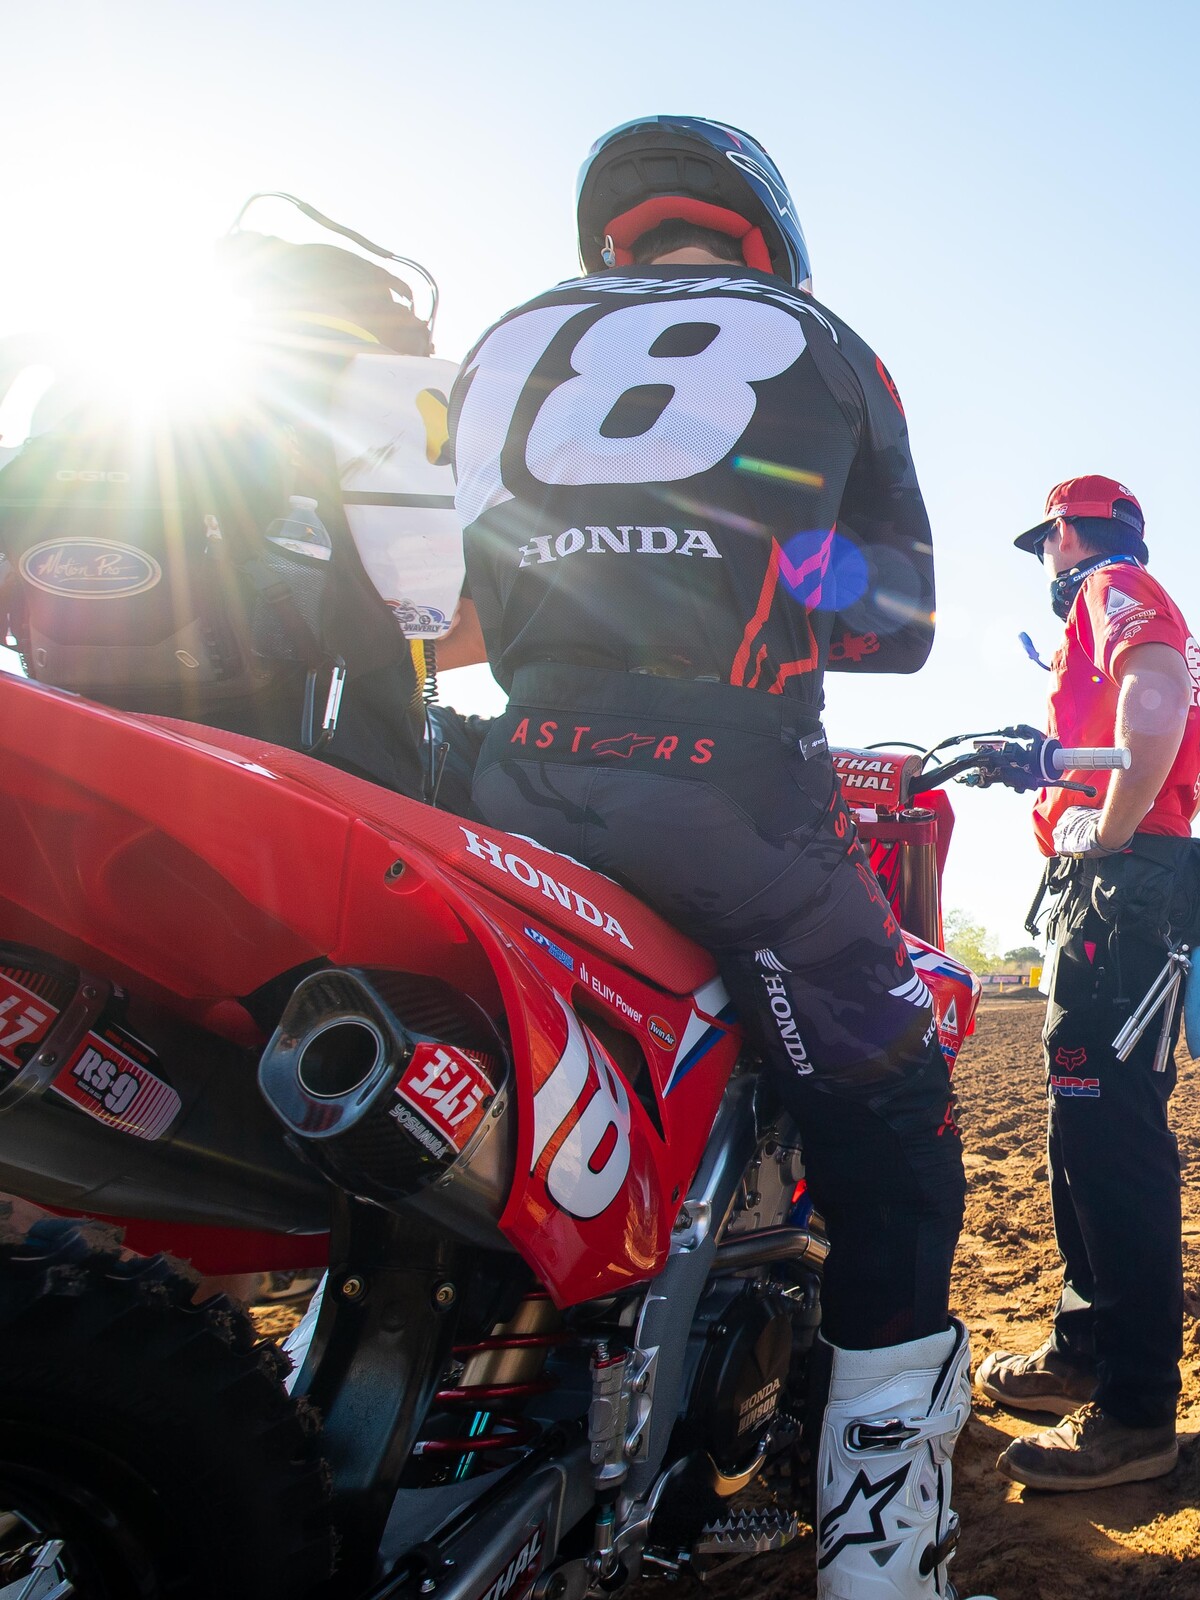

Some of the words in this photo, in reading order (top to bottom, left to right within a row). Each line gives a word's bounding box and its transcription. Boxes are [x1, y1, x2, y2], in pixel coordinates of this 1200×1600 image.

[454, 297, 807, 530] 18
[38, 548, 94, 578] Motion
[518, 526, 723, 568] HONDA
[458, 825, 634, 950] HONDA
[615, 994, 643, 1024] Power
[649, 1021, 665, 1038] Twin
[664, 1032, 675, 1045] Air
[761, 973, 815, 1077] HONDA
[407, 1048, 484, 1127] ヨシムラ
[388, 1102, 448, 1160] YOSHIMURA
[739, 1378, 781, 1416] HONDA
